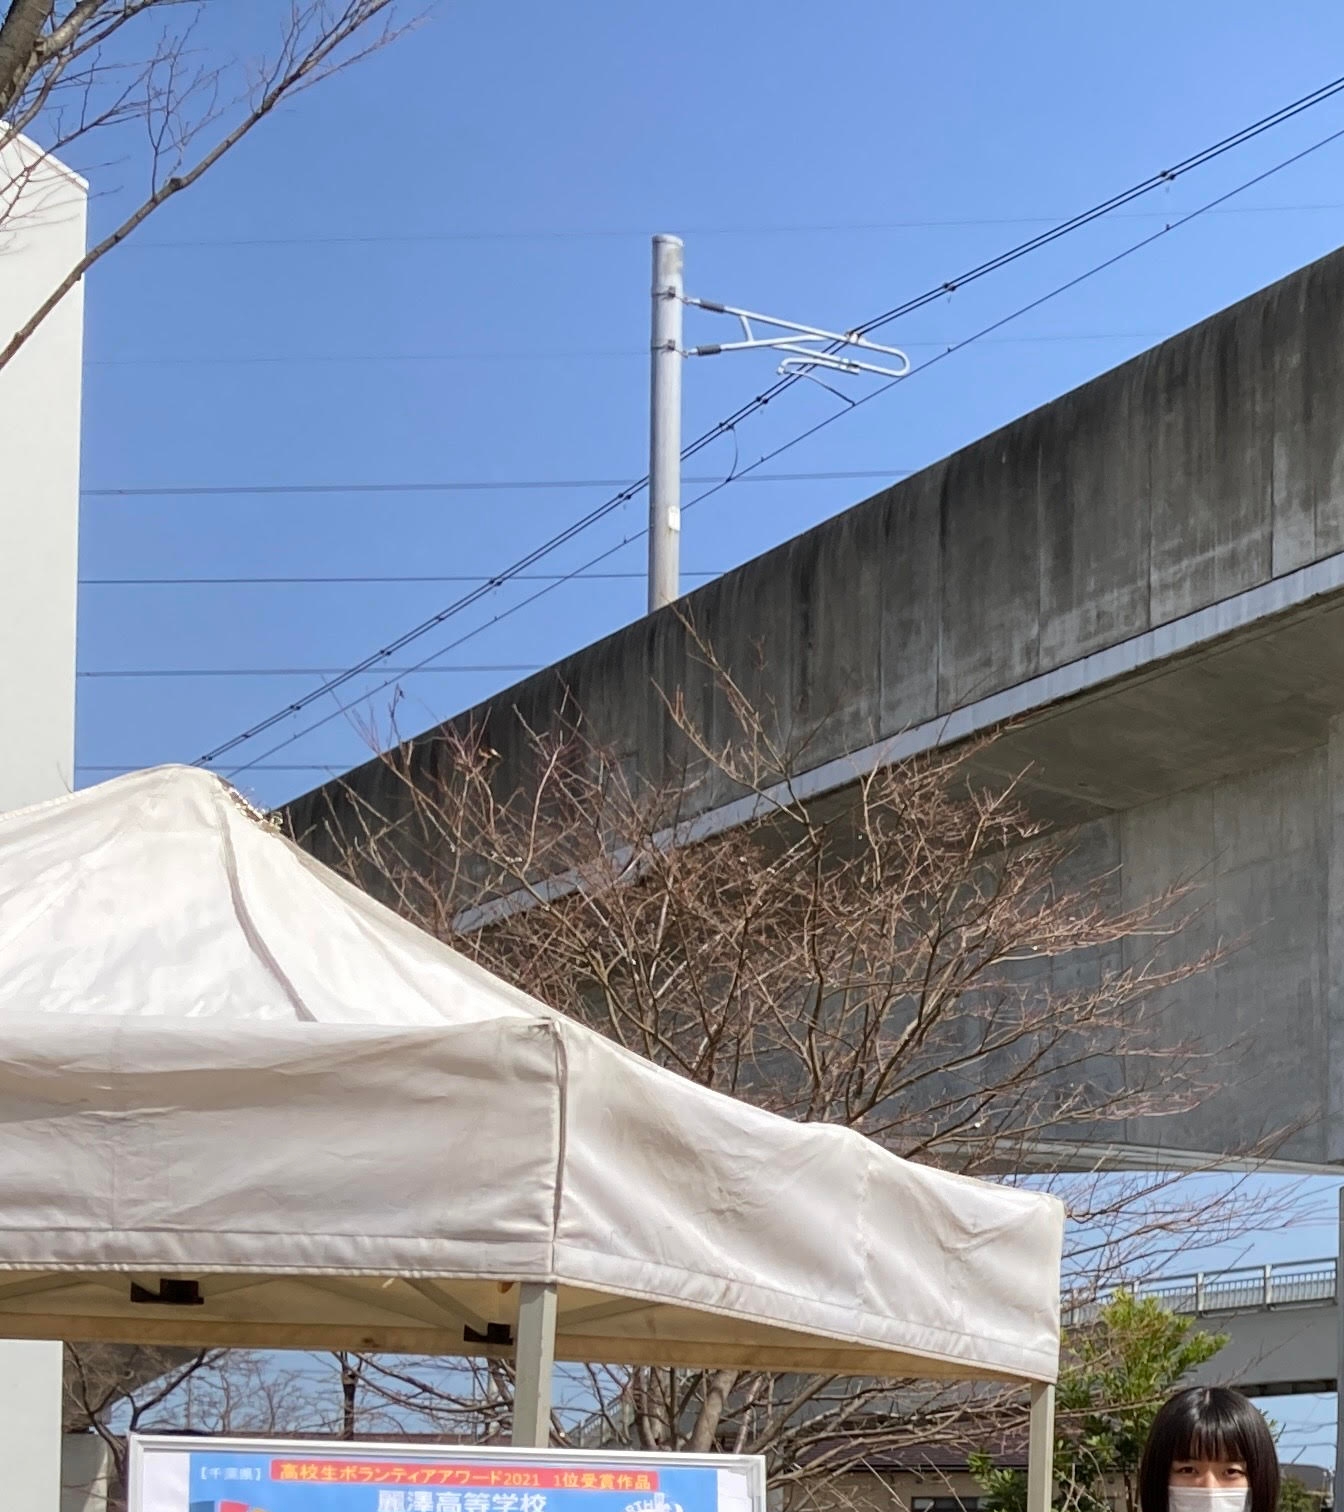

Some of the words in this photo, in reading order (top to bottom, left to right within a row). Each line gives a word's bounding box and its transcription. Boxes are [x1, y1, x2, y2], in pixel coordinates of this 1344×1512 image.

[279, 1464, 541, 1486] 高校生ボランティアアワード2021
[553, 1472, 651, 1489] 1位受賞作品
